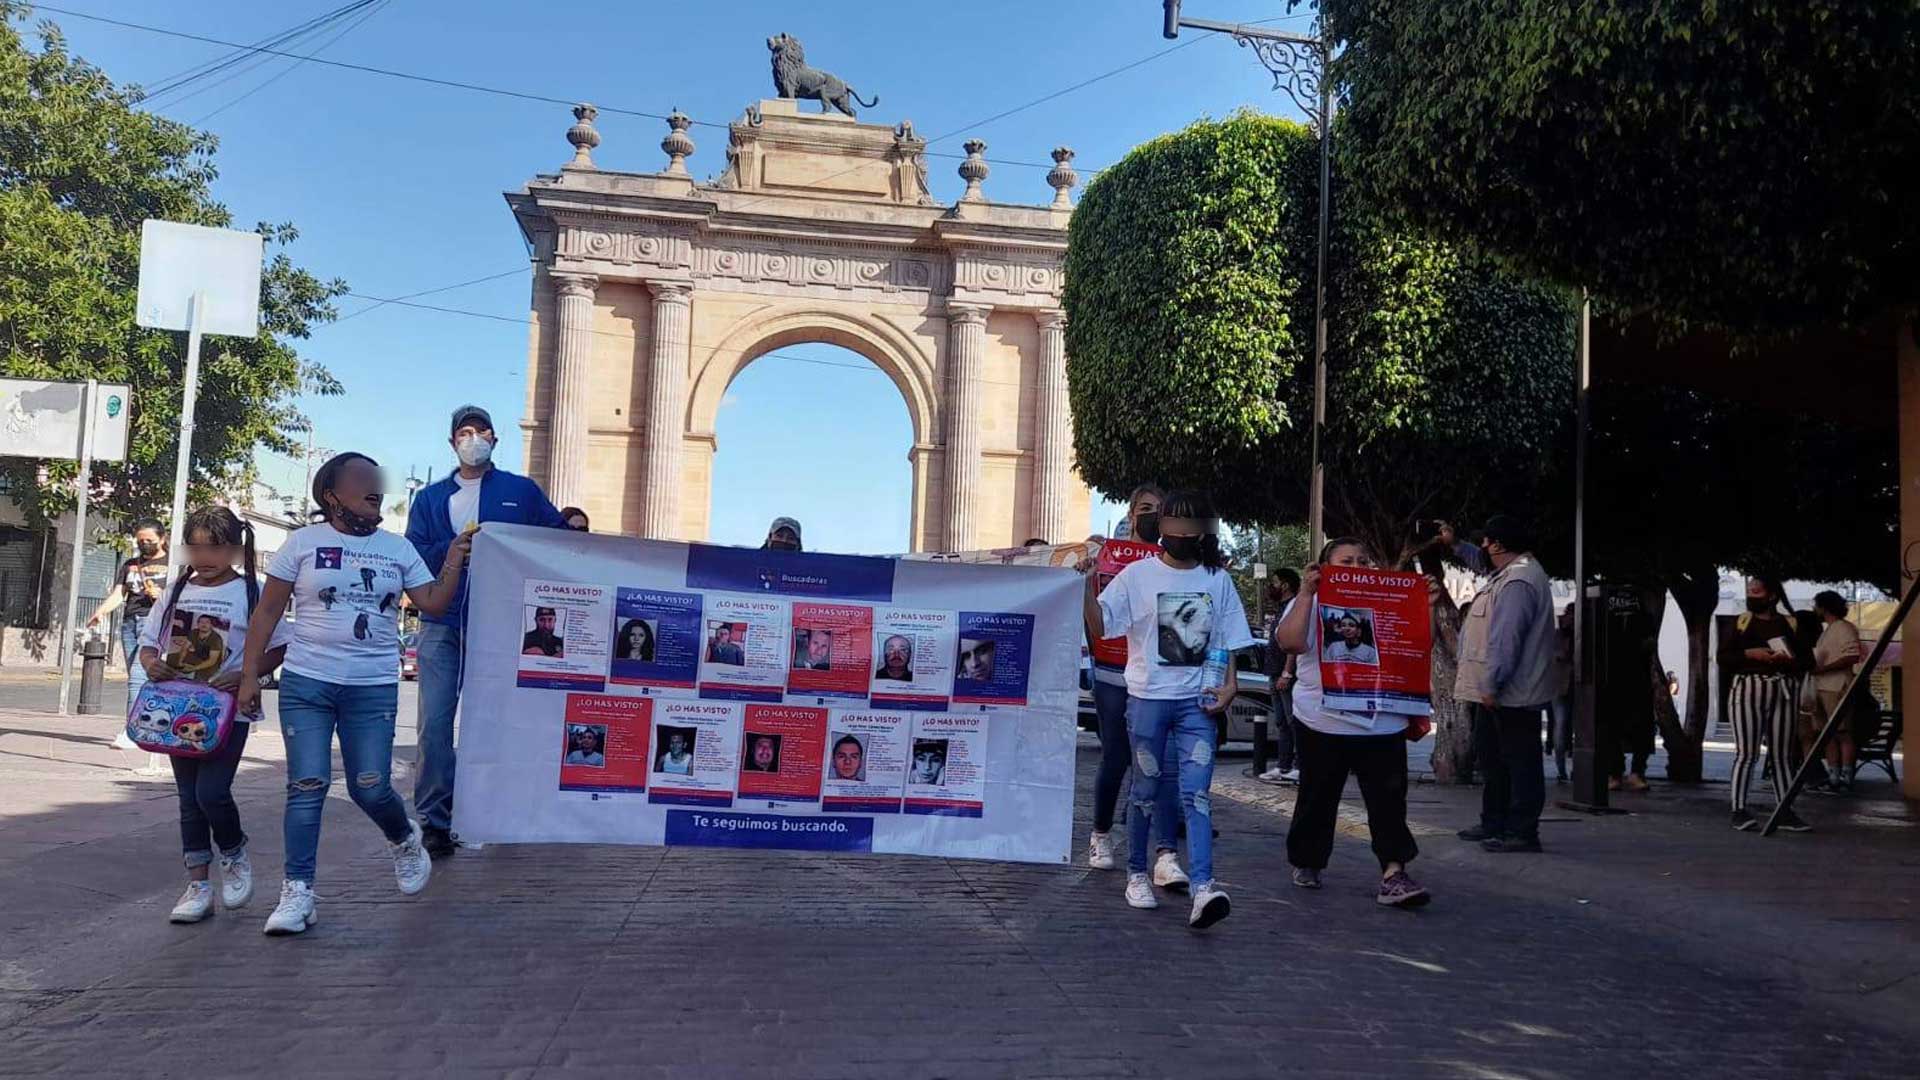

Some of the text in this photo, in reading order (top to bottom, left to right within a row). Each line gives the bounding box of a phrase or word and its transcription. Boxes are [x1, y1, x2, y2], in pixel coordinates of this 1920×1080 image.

[781, 574, 828, 585] Buscadoras
[1329, 572, 1416, 588] ¿LO HAS VISTO?
[552, 585, 570, 595] HAS
[644, 595, 662, 603] HAS
[733, 602, 749, 610] HAS
[818, 608, 834, 616] HAS
[901, 613, 917, 621] HAS
[594, 700, 612, 708] HAS
[772, 710, 789, 718] HAS
[692, 814, 849, 833] Te seguimos buscando.
